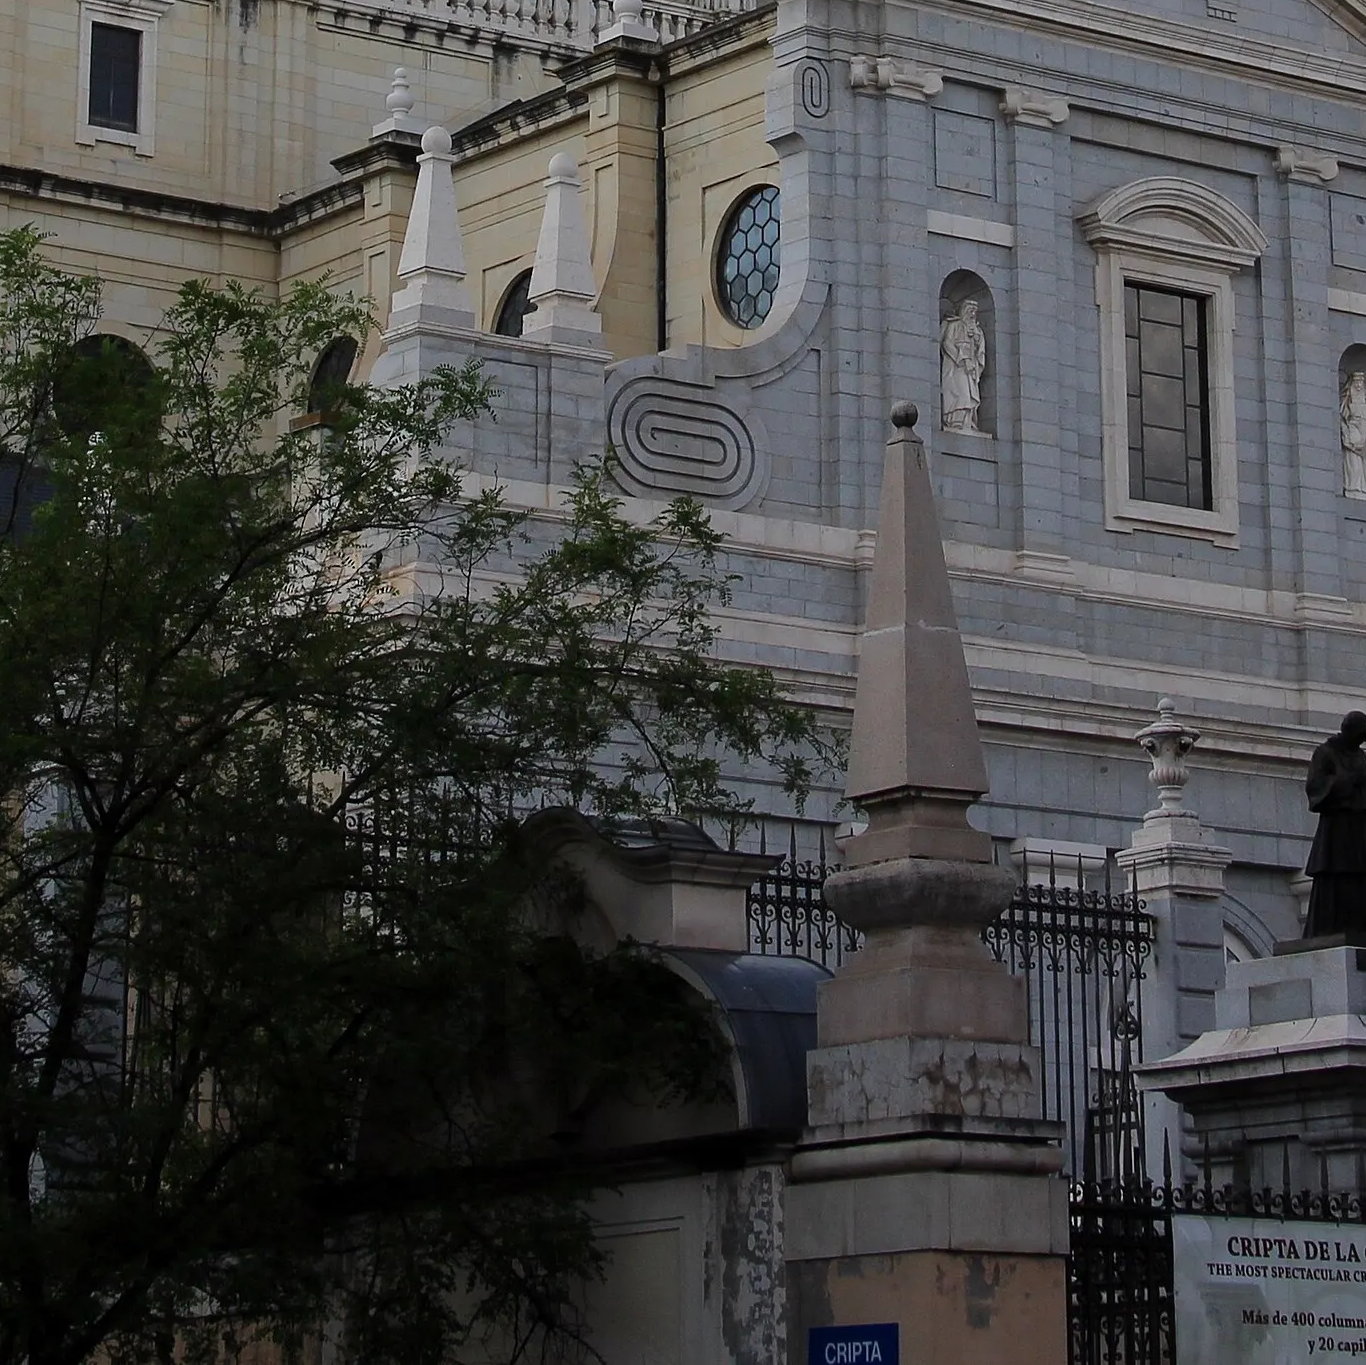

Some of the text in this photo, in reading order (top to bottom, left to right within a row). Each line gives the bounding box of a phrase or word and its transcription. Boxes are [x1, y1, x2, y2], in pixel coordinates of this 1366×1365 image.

[1227, 1236, 1300, 1259] CRIPTA
[1304, 1240, 1330, 1261] DE
[1335, 1242, 1360, 1262] LA
[1207, 1263, 1232, 1276] THE
[1235, 1265, 1268, 1278] MOST
[1271, 1266, 1351, 1282] SPECTACULAR
[1242, 1309, 1269, 1325] Más
[1273, 1311, 1287, 1325] de
[1291, 1313, 1315, 1326] 400
[824, 1340, 882, 1365] CRIPTA
[1308, 1340, 1316, 1355] y
[1318, 1337, 1334, 1351] 20
